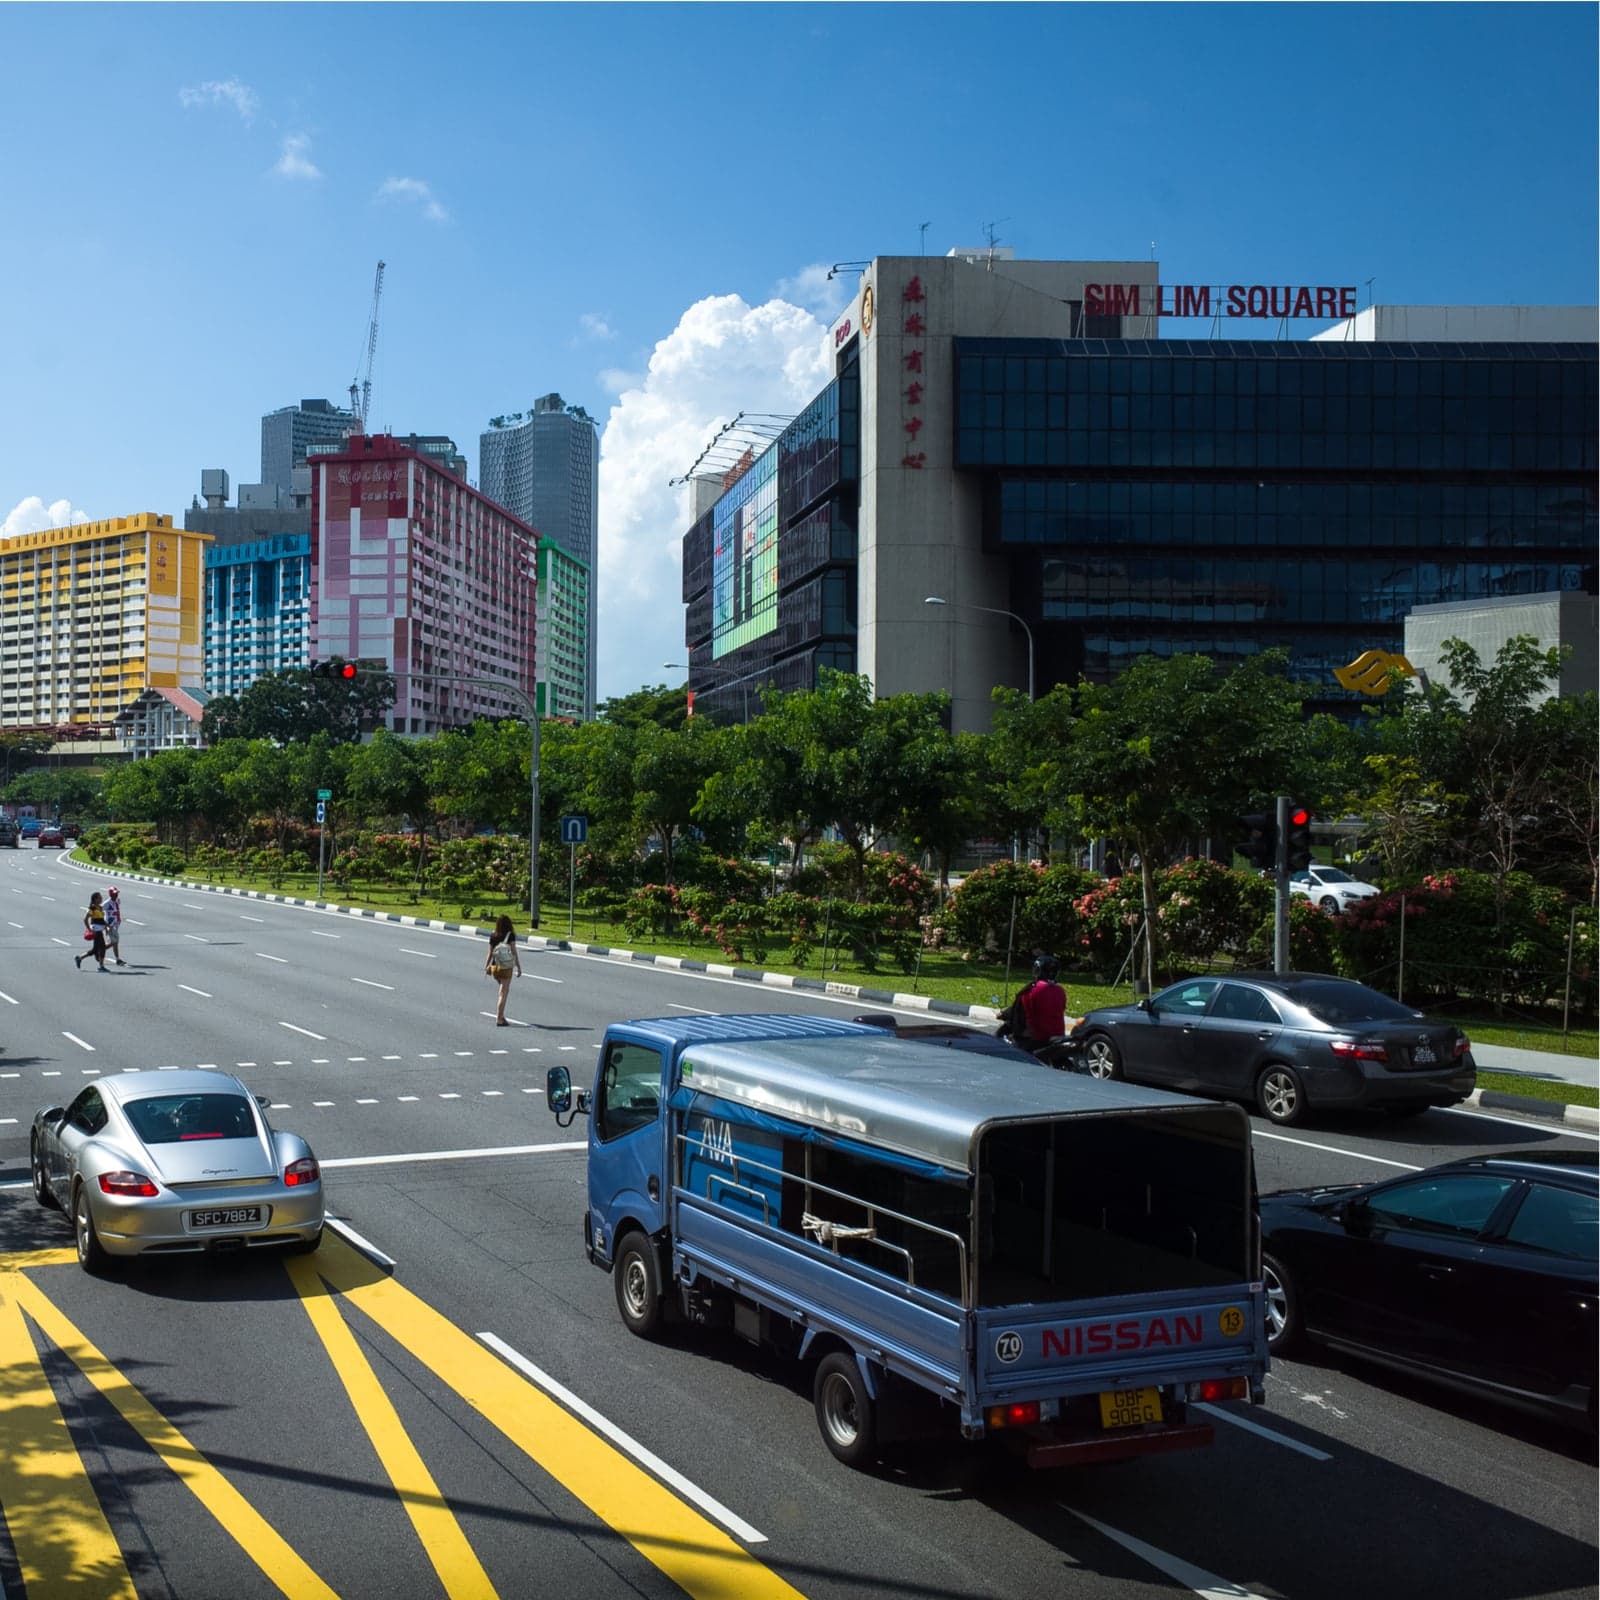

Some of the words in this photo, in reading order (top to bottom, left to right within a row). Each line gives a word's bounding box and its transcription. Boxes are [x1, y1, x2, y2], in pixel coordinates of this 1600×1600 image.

[1084, 283, 1140, 316] SIM
[1156, 285, 1210, 317] LIM
[1226, 285, 1357, 319] SQUARE
[700, 1118, 734, 1166] AVA
[1223, 1311, 1240, 1328] 13
[1000, 1336, 1020, 1354] 70
[1041, 1315, 1203, 1358] NISSAN
[1110, 1405, 1153, 1426] 906G
